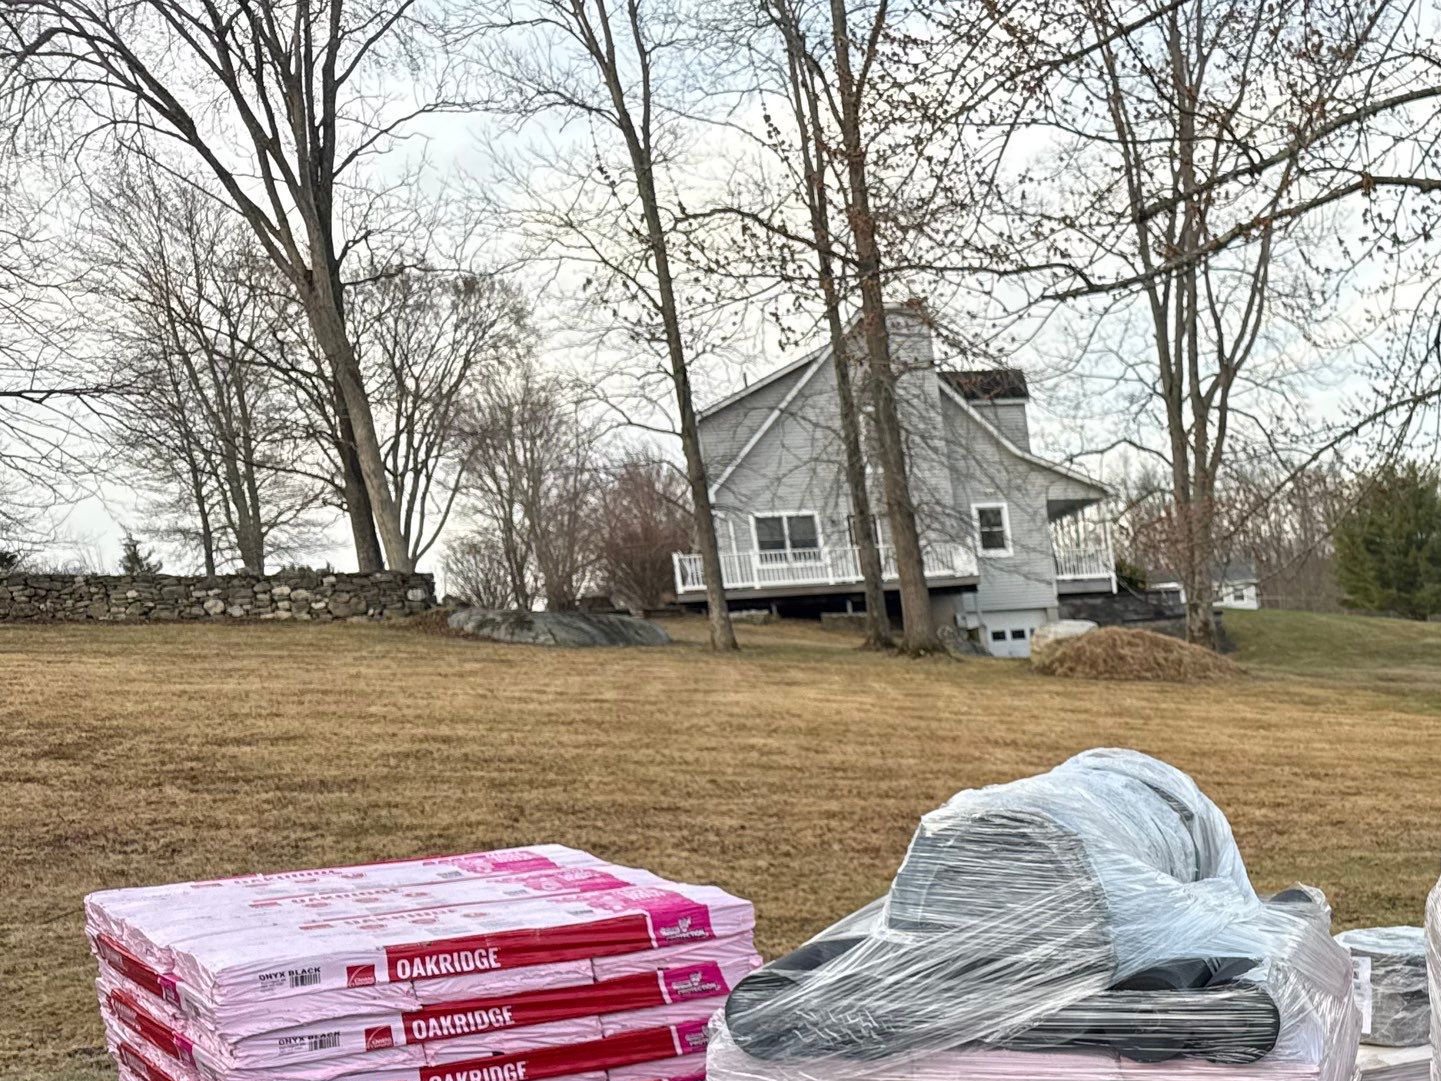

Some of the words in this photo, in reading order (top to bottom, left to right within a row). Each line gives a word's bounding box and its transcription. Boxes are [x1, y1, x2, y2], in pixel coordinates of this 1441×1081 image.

[258, 972, 285, 981] ONYX
[288, 966, 321, 976] BLACK
[397, 947, 501, 980] OAKRIDGE
[412, 1005, 515, 1040] OAKRIDGE
[278, 1036, 306, 1046] ONYX
